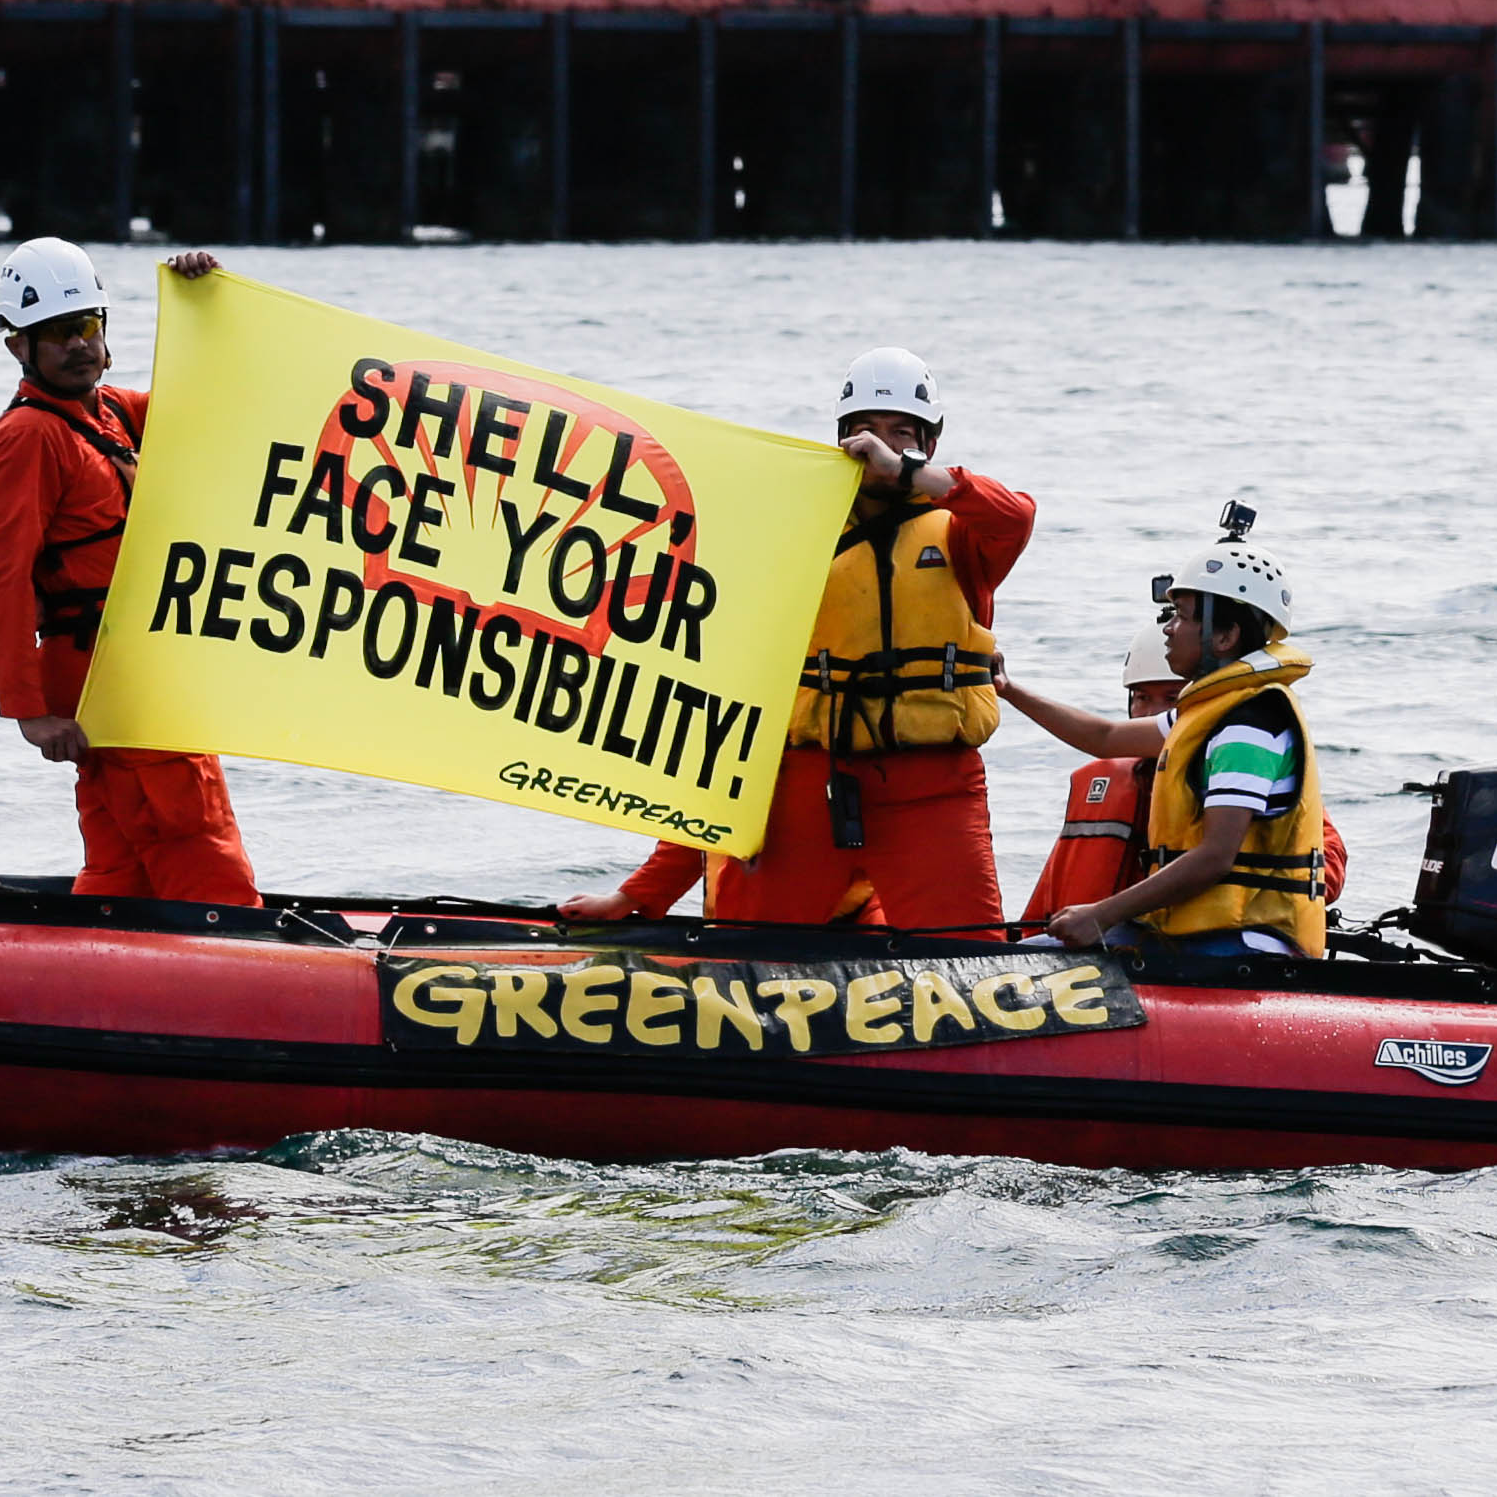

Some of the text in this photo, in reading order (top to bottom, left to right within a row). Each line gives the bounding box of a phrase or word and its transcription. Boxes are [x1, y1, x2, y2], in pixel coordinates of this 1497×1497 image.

[340, 358, 695, 547] SHELL,
[254, 442, 717, 663] FACE YOUR
[149, 542, 763, 801] RESPONSIBILITY!
[500, 760, 732, 844] GREENPEACE
[392, 965, 1110, 1052] GREENPEACE
[1380, 1042, 1467, 1067] Achilles
